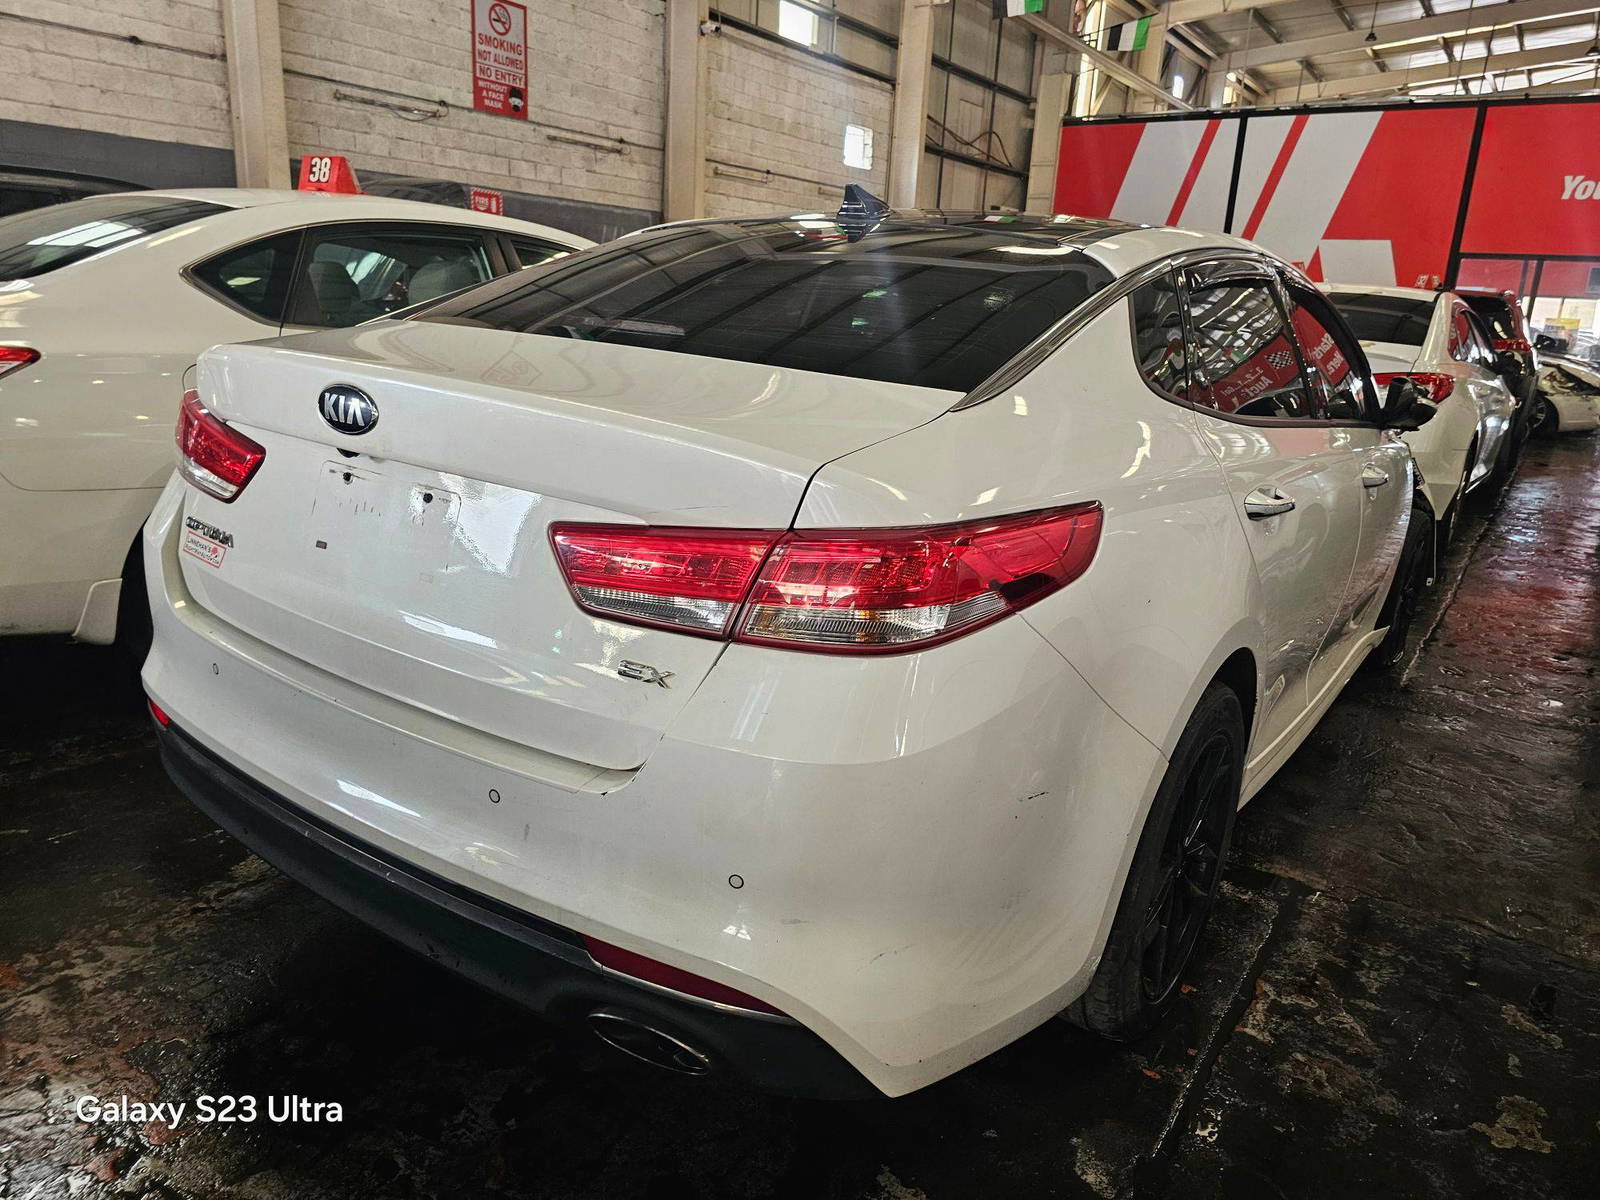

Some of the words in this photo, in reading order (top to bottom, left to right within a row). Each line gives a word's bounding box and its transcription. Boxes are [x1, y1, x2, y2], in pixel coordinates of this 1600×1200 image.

[478, 33, 522, 55] SMOKING
[478, 49, 491, 62] NOT
[493, 53, 523, 70] ALLOWED
[478, 80, 508, 92] WITHOUT
[479, 66, 492, 78] NO
[495, 70, 522, 86] ENTRY
[484, 99, 503, 109] MASK
[489, 91, 504, 101] FACE
[309, 156, 332, 183] 38
[324, 392, 365, 427] KIA
[618, 660, 675, 689] EX
